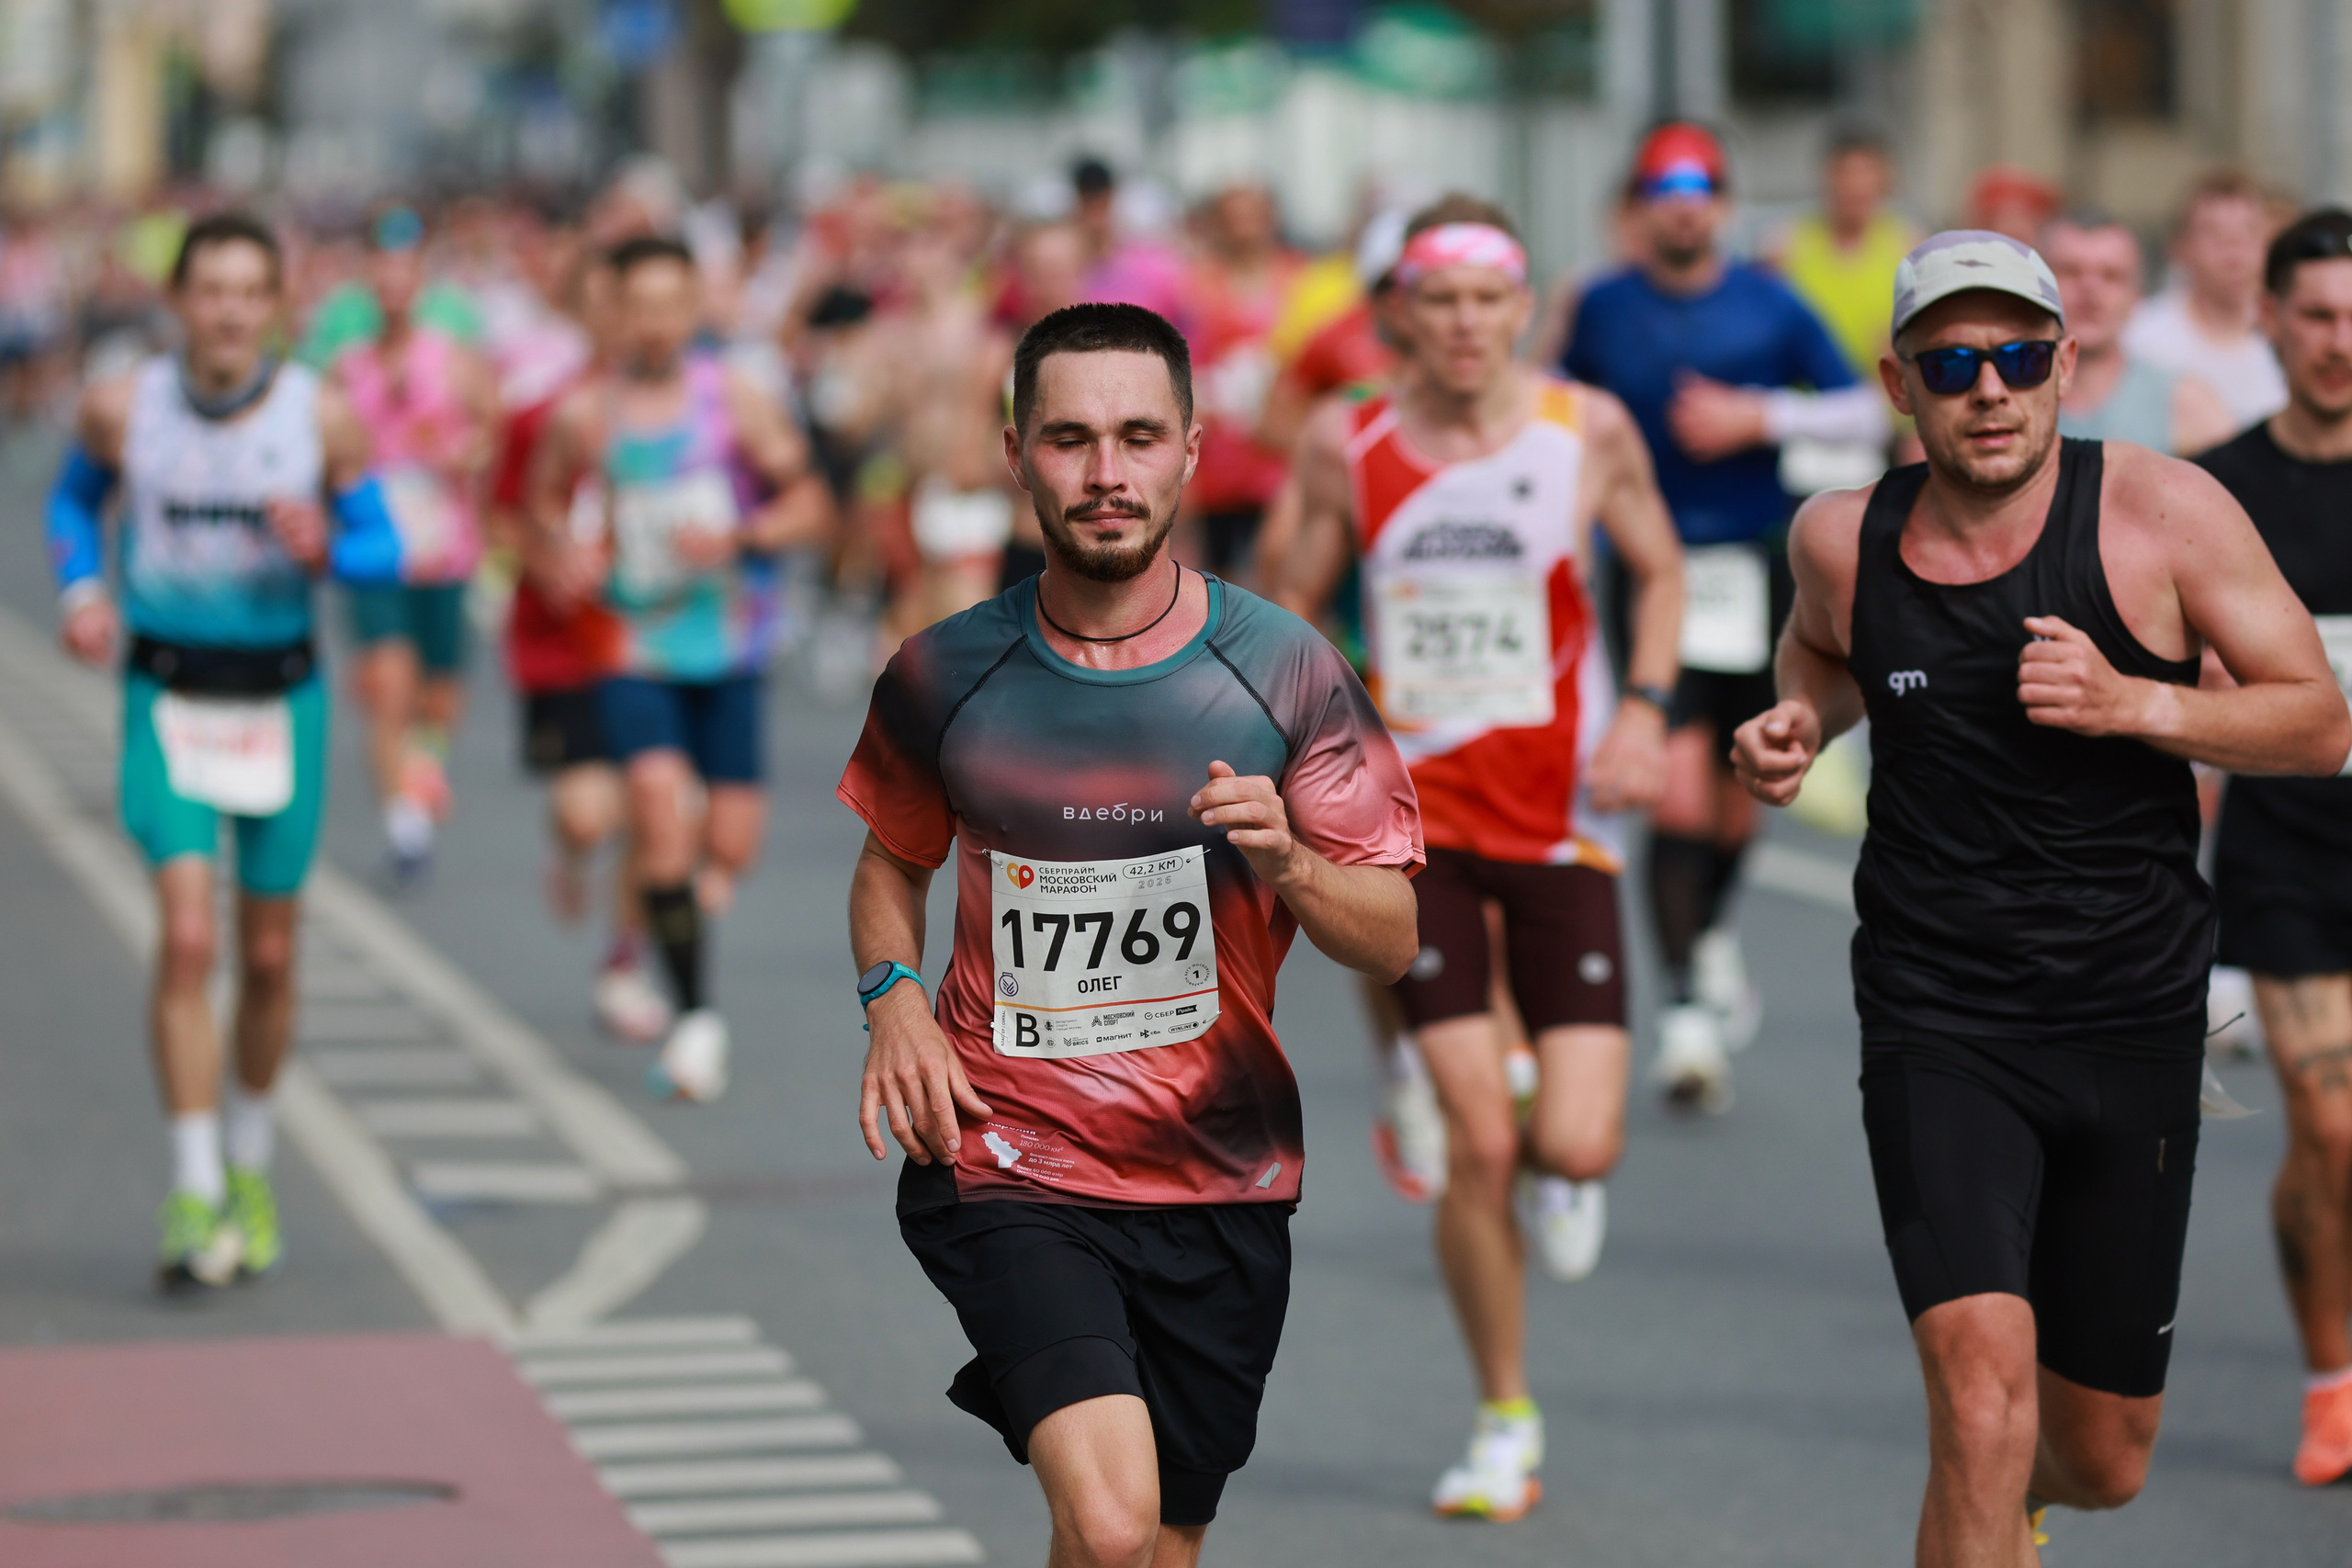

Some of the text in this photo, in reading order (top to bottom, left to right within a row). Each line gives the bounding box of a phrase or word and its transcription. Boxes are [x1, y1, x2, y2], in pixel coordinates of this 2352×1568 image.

[1888, 670, 1928, 696] gm
[1063, 802, 1163, 826] вдебри
[1039, 866, 1095, 874] СБЕРПРАЙМ
[1129, 863, 1154, 876] 42,2
[1039, 873, 1117, 885] МОСКОВСКИЙ
[1137, 875, 1172, 890] 2026
[1040, 885, 1097, 894] МАРАФОН
[1001, 901, 1201, 972] 17769
[1193, 970, 1199, 978] 1
[1078, 976, 1123, 994] ОЛЕГ
[1155, 1010, 1174, 1019] СБЕР
[1035, 1142, 1050, 1151] 000
